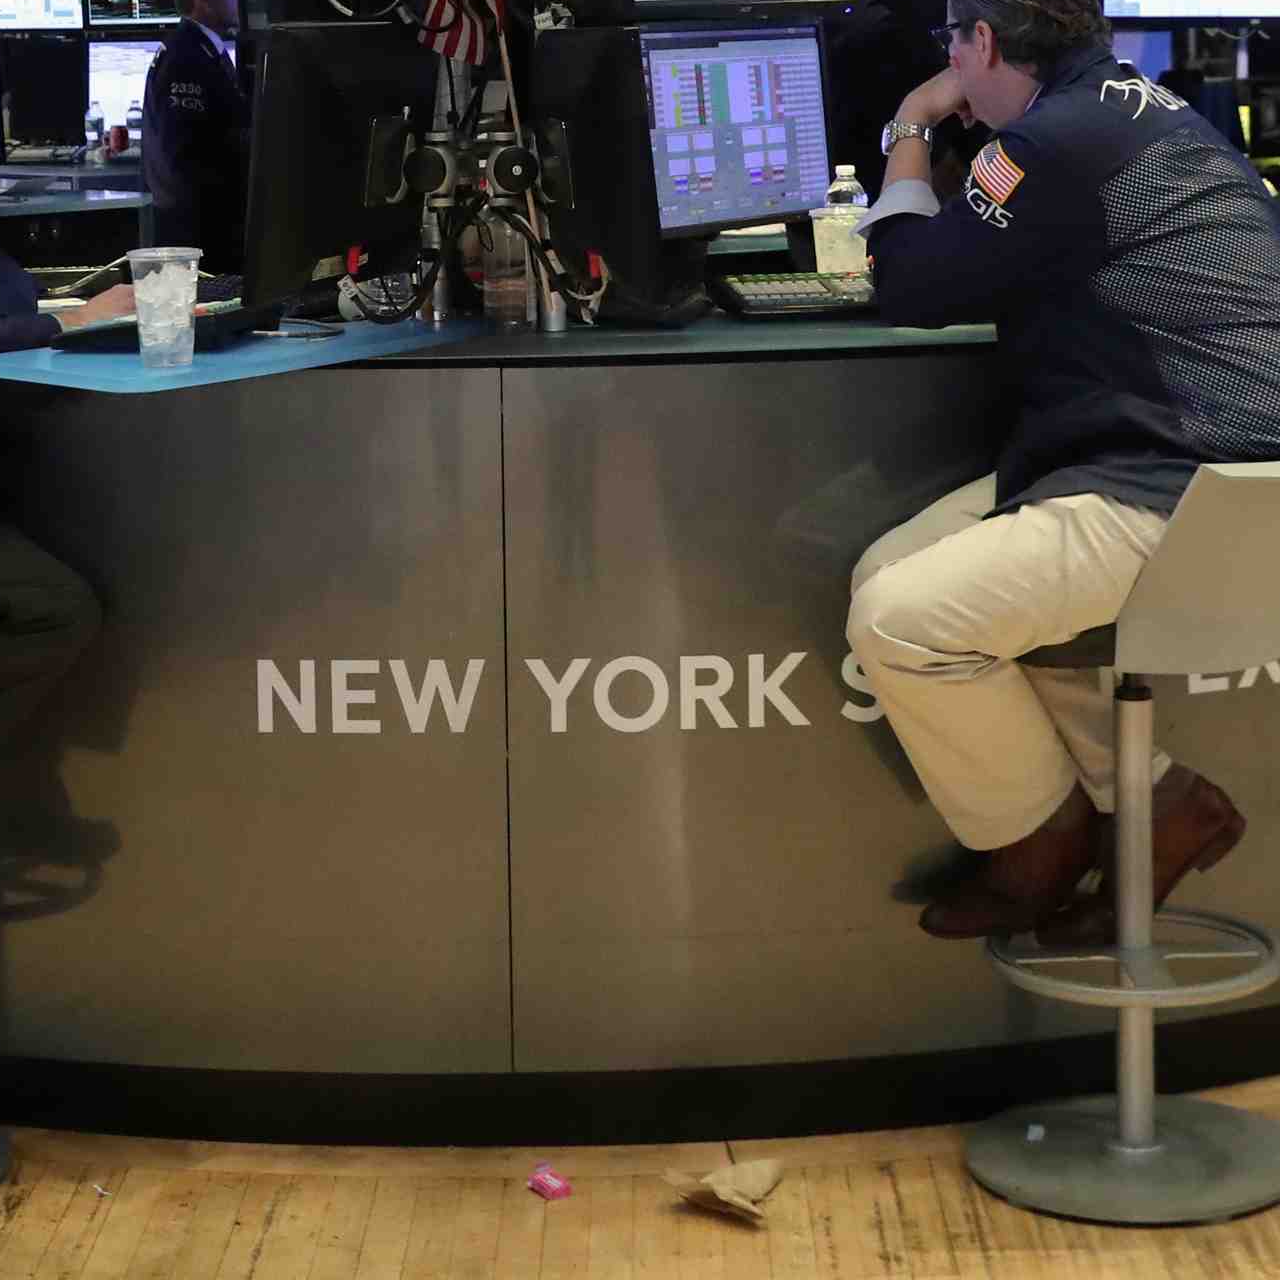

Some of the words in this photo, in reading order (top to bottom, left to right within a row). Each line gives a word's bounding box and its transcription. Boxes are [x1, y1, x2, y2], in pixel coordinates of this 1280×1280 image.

[967, 188, 1014, 230] GTS
[256, 658, 485, 733] NEW
[524, 651, 811, 734] YORK
